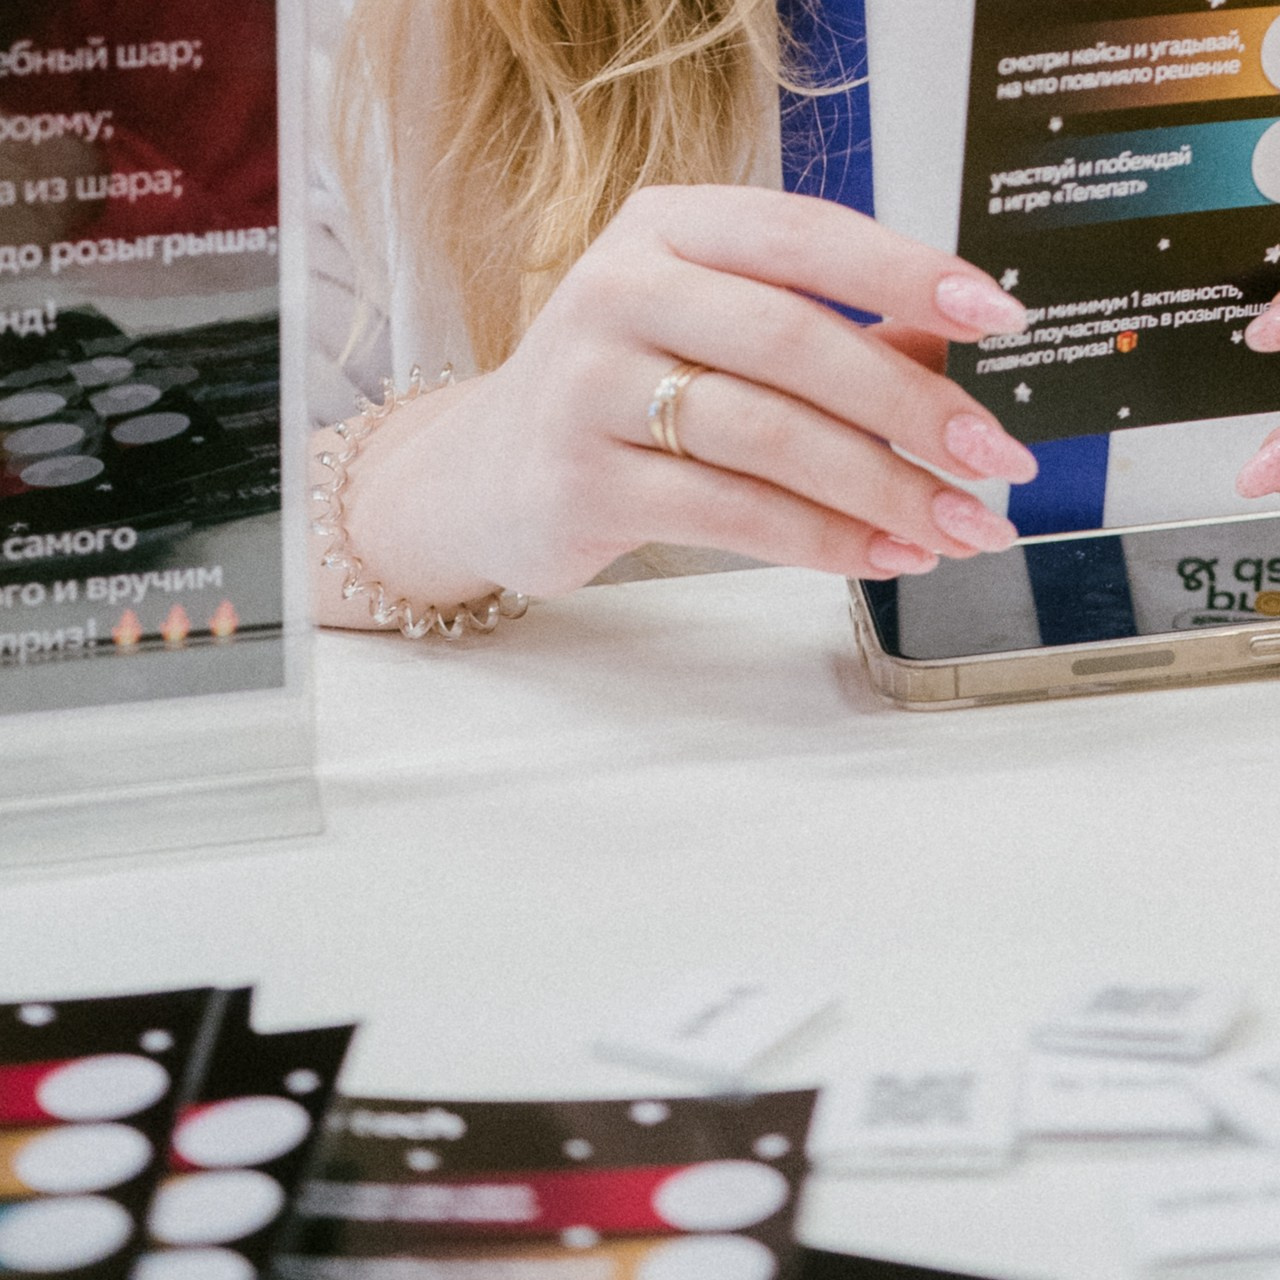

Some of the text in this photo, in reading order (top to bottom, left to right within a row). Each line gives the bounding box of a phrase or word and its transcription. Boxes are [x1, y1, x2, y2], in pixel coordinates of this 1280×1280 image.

[116, 40, 203, 72] шар;
[997, 29, 1246, 75] смотри кейсы и угадывай,
[996, 58, 1242, 100] на что повлияло решение
[23, 177, 68, 204] из
[75, 169, 183, 204] шара;
[990, 144, 1194, 194] участвуй и побеждай
[988, 178, 1150, 215] в игре «Телепат»
[50, 226, 279, 275] розыгрыша;
[1047, 297, 1129, 320] минимум
[1130, 290, 1140, 309] 1
[1141, 284, 1244, 308] активность,
[977, 331, 1032, 352] чтобы
[1033, 311, 1159, 345] поучаствовать
[1160, 311, 1172, 327] в
[976, 336, 1116, 375] главного приза!
[2, 526, 138, 561] самого
[53, 579, 78, 603] и
[86, 565, 223, 606] вручим
